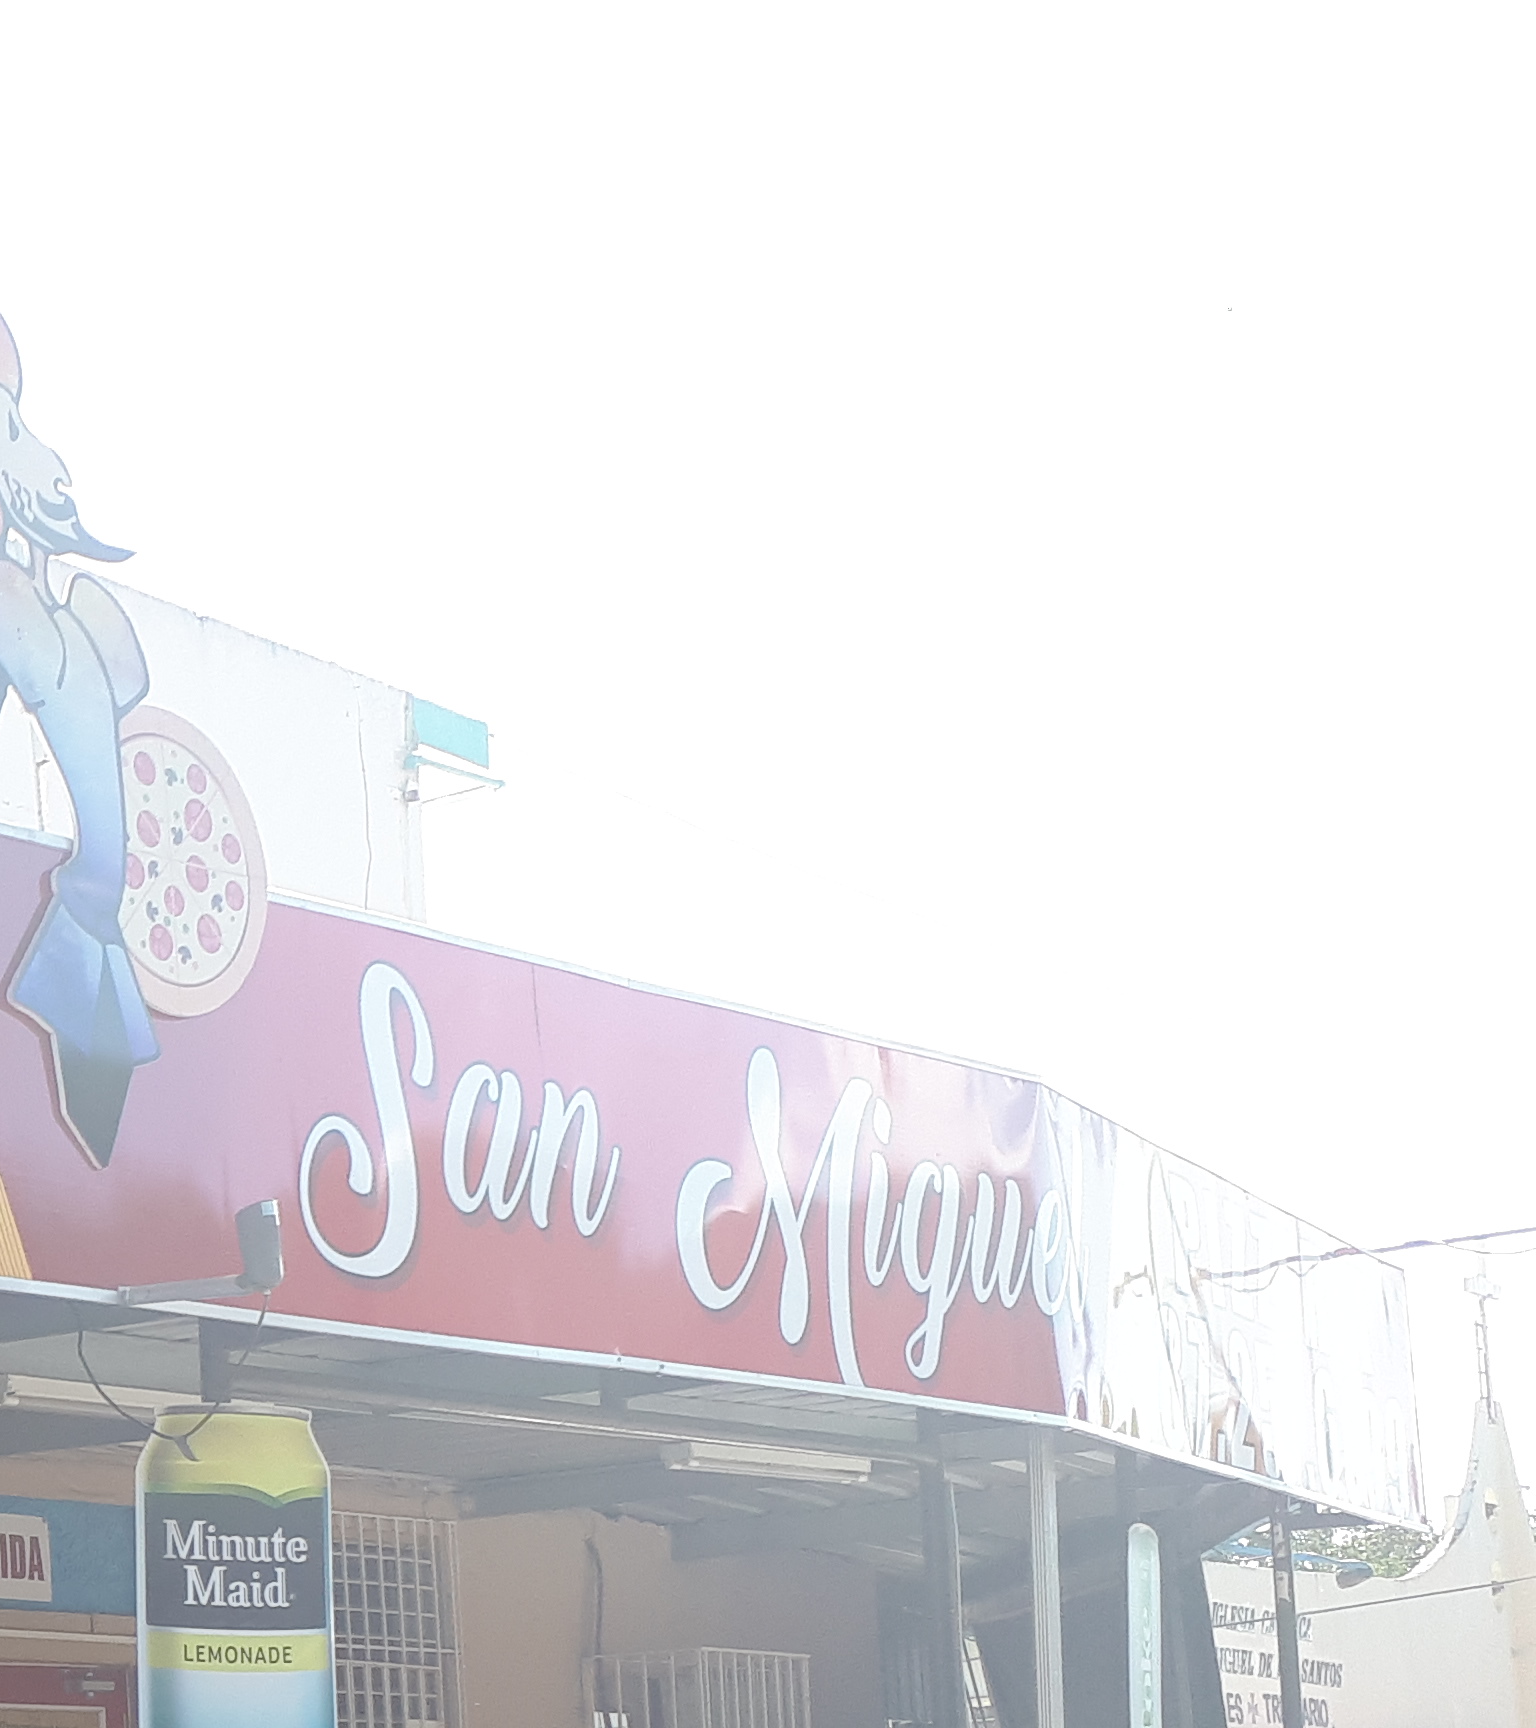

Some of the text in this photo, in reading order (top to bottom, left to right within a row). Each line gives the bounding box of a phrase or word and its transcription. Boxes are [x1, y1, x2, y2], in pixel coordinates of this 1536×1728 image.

[299, 961, 622, 1278] San
[675, 1046, 1091, 1388] Miguel
[162, 1518, 309, 1563] Minute
[183, 1564, 290, 1608] Maid
[1211, 1601, 1256, 1632] IGLESIA
[182, 1643, 293, 1664] LEMONADE
[1218, 1647, 1344, 1688] IGUEL DE SANTOS
